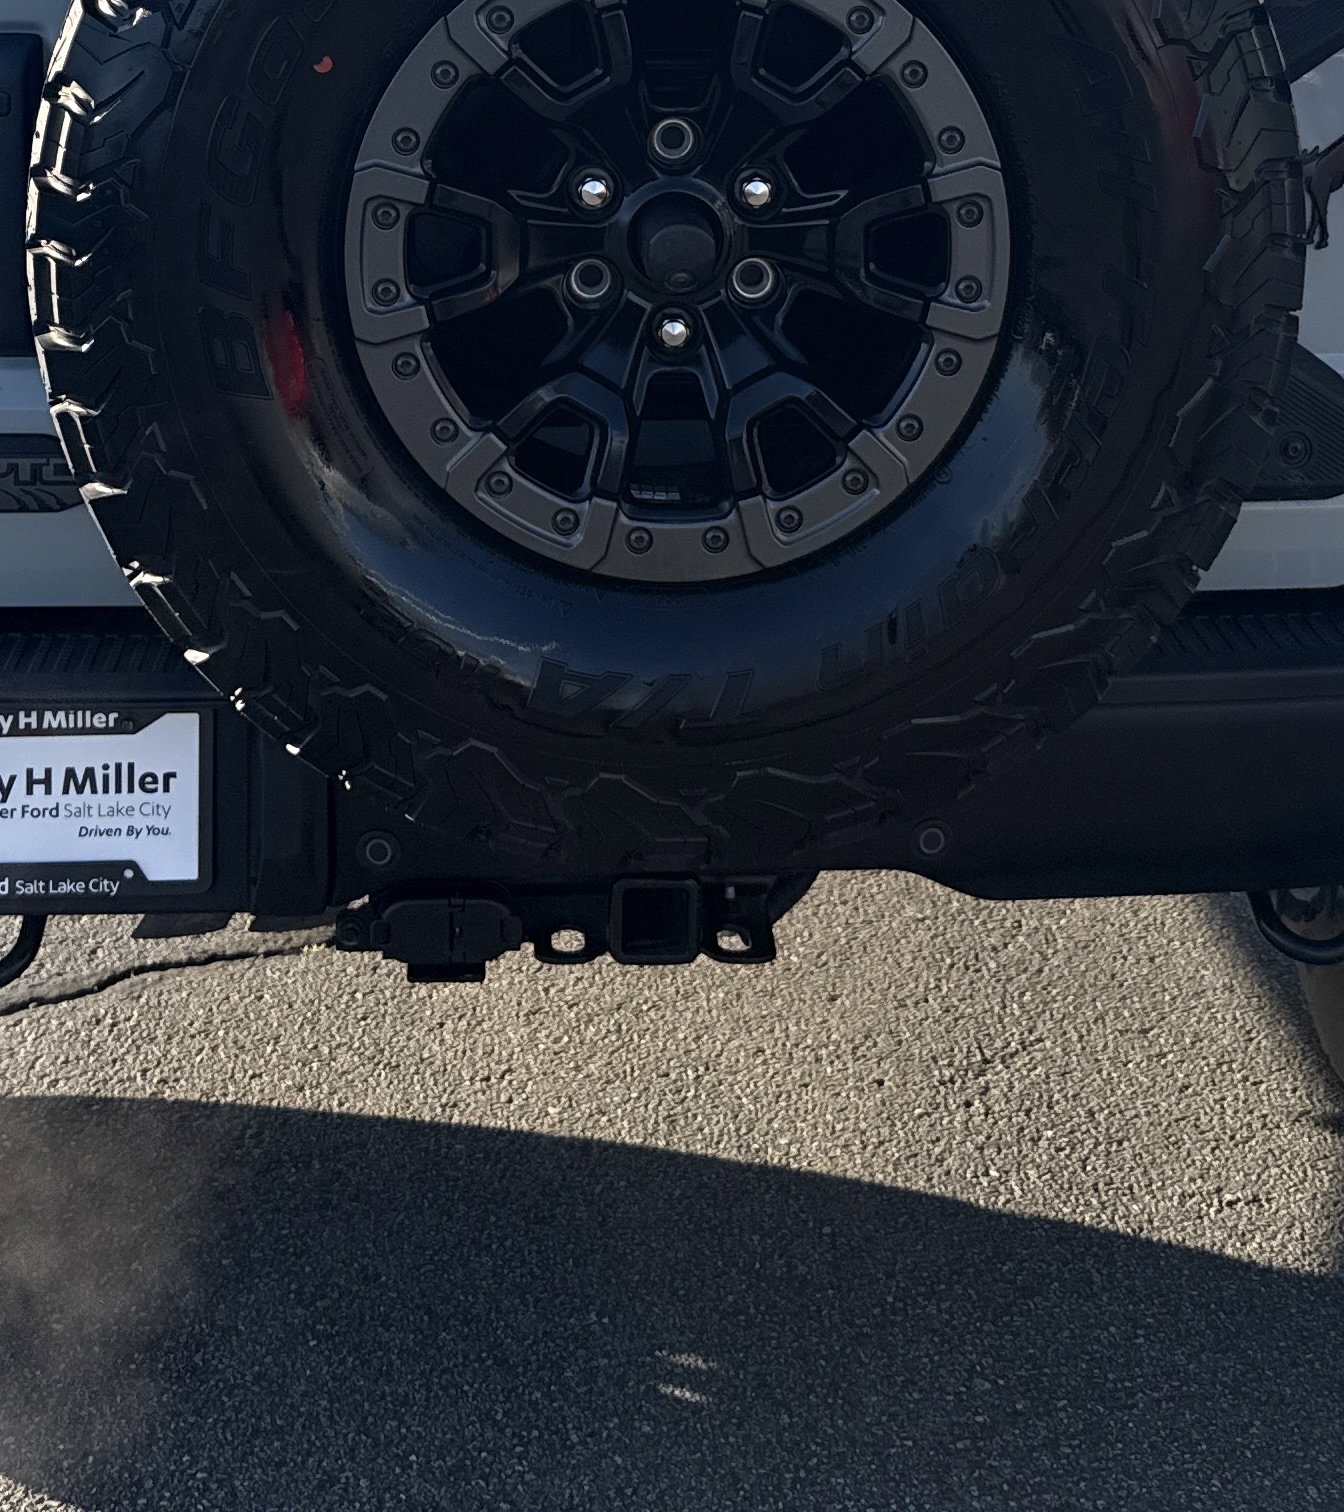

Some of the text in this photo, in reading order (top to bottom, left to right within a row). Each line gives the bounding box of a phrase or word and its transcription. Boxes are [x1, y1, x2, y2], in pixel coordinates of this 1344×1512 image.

[18, 711, 38, 730] H
[42, 710, 119, 729] Miller
[26, 767, 53, 796] H
[62, 762, 177, 795] Miller
[21, 802, 59, 819] Ford
[63, 802, 93, 818] Salt
[98, 802, 136, 818] Lake
[140, 802, 172, 820] City
[78, 824, 122, 838] Driven
[126, 825, 143, 839] By
[15, 878, 45, 894] Salt
[49, 878, 86, 894] Lake
[89, 877, 120, 896] City
